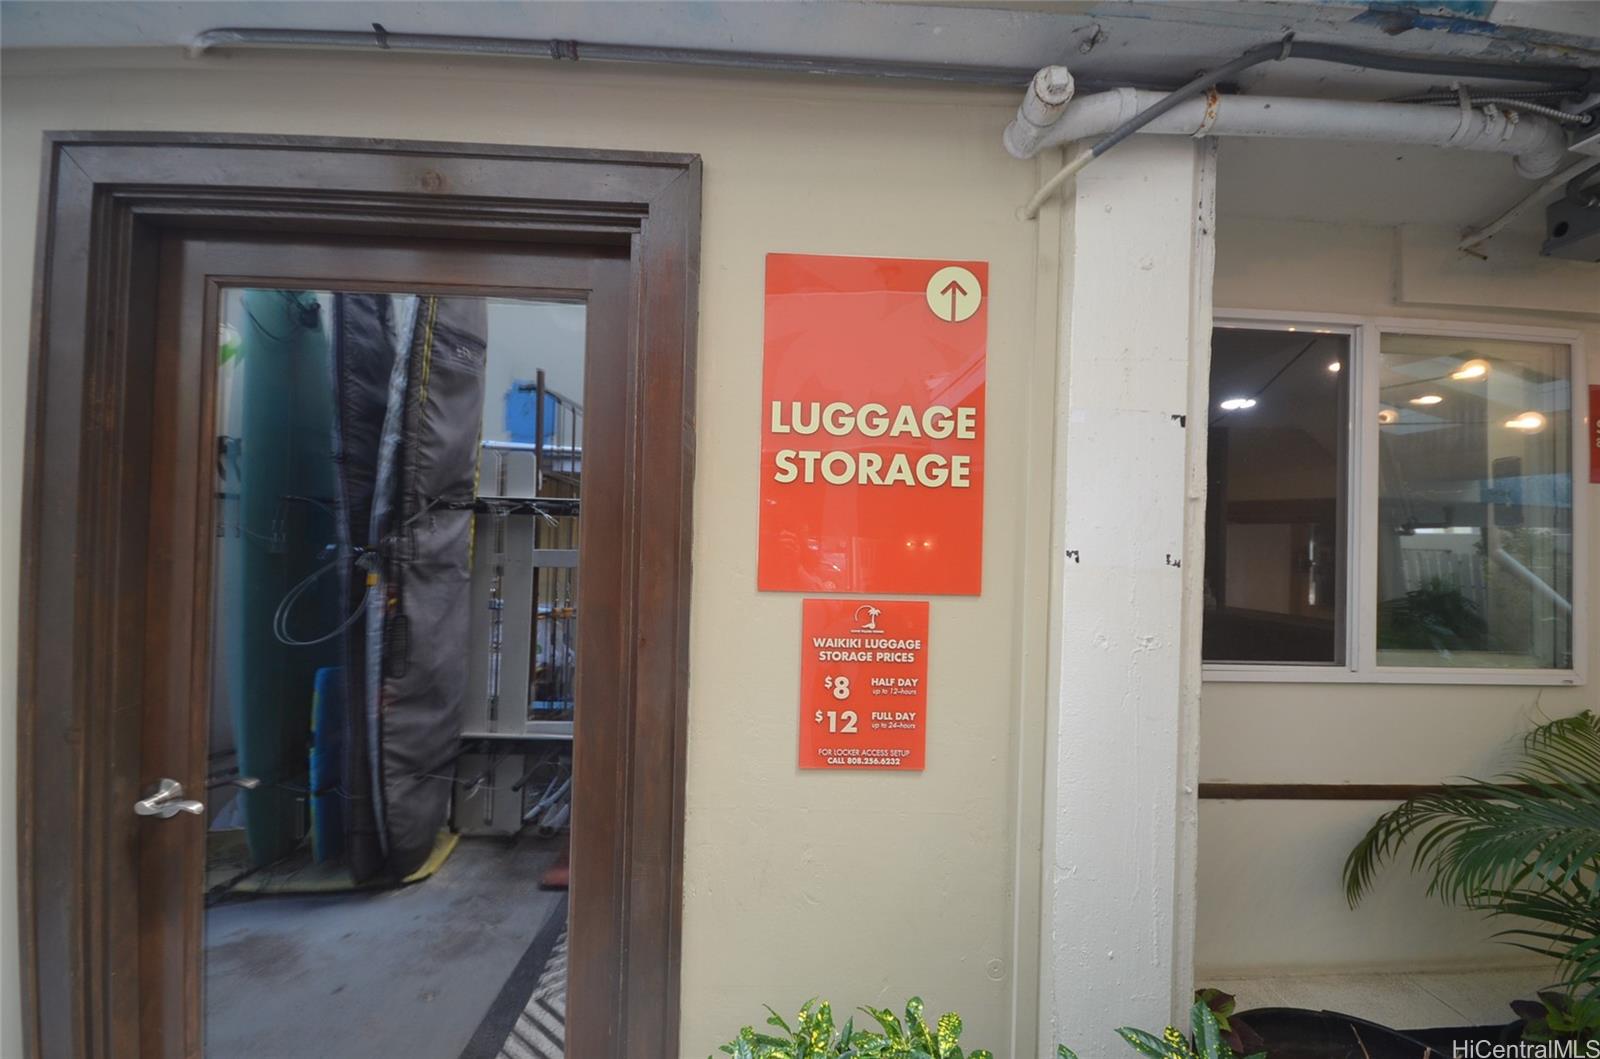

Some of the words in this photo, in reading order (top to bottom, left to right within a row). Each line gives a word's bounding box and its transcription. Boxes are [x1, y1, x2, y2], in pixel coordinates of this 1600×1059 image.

[771, 400, 977, 440] LUGGAGE
[774, 449, 971, 488] STORAGE
[813, 637, 861, 648] WAIKIKI
[865, 639, 921, 649] LUGGAGE
[819, 651, 872, 661] STORAGE
[876, 652, 915, 662] PRICES
[824, 675, 850, 700] $8
[871, 678, 896, 687] HALF
[898, 678, 919, 687] DAY
[815, 709, 858, 733] $12
[871, 711, 893, 720] FULL
[896, 712, 916, 720] DAY
[818, 748, 832, 756] FOR
[847, 757, 901, 765] 808.256.6232
